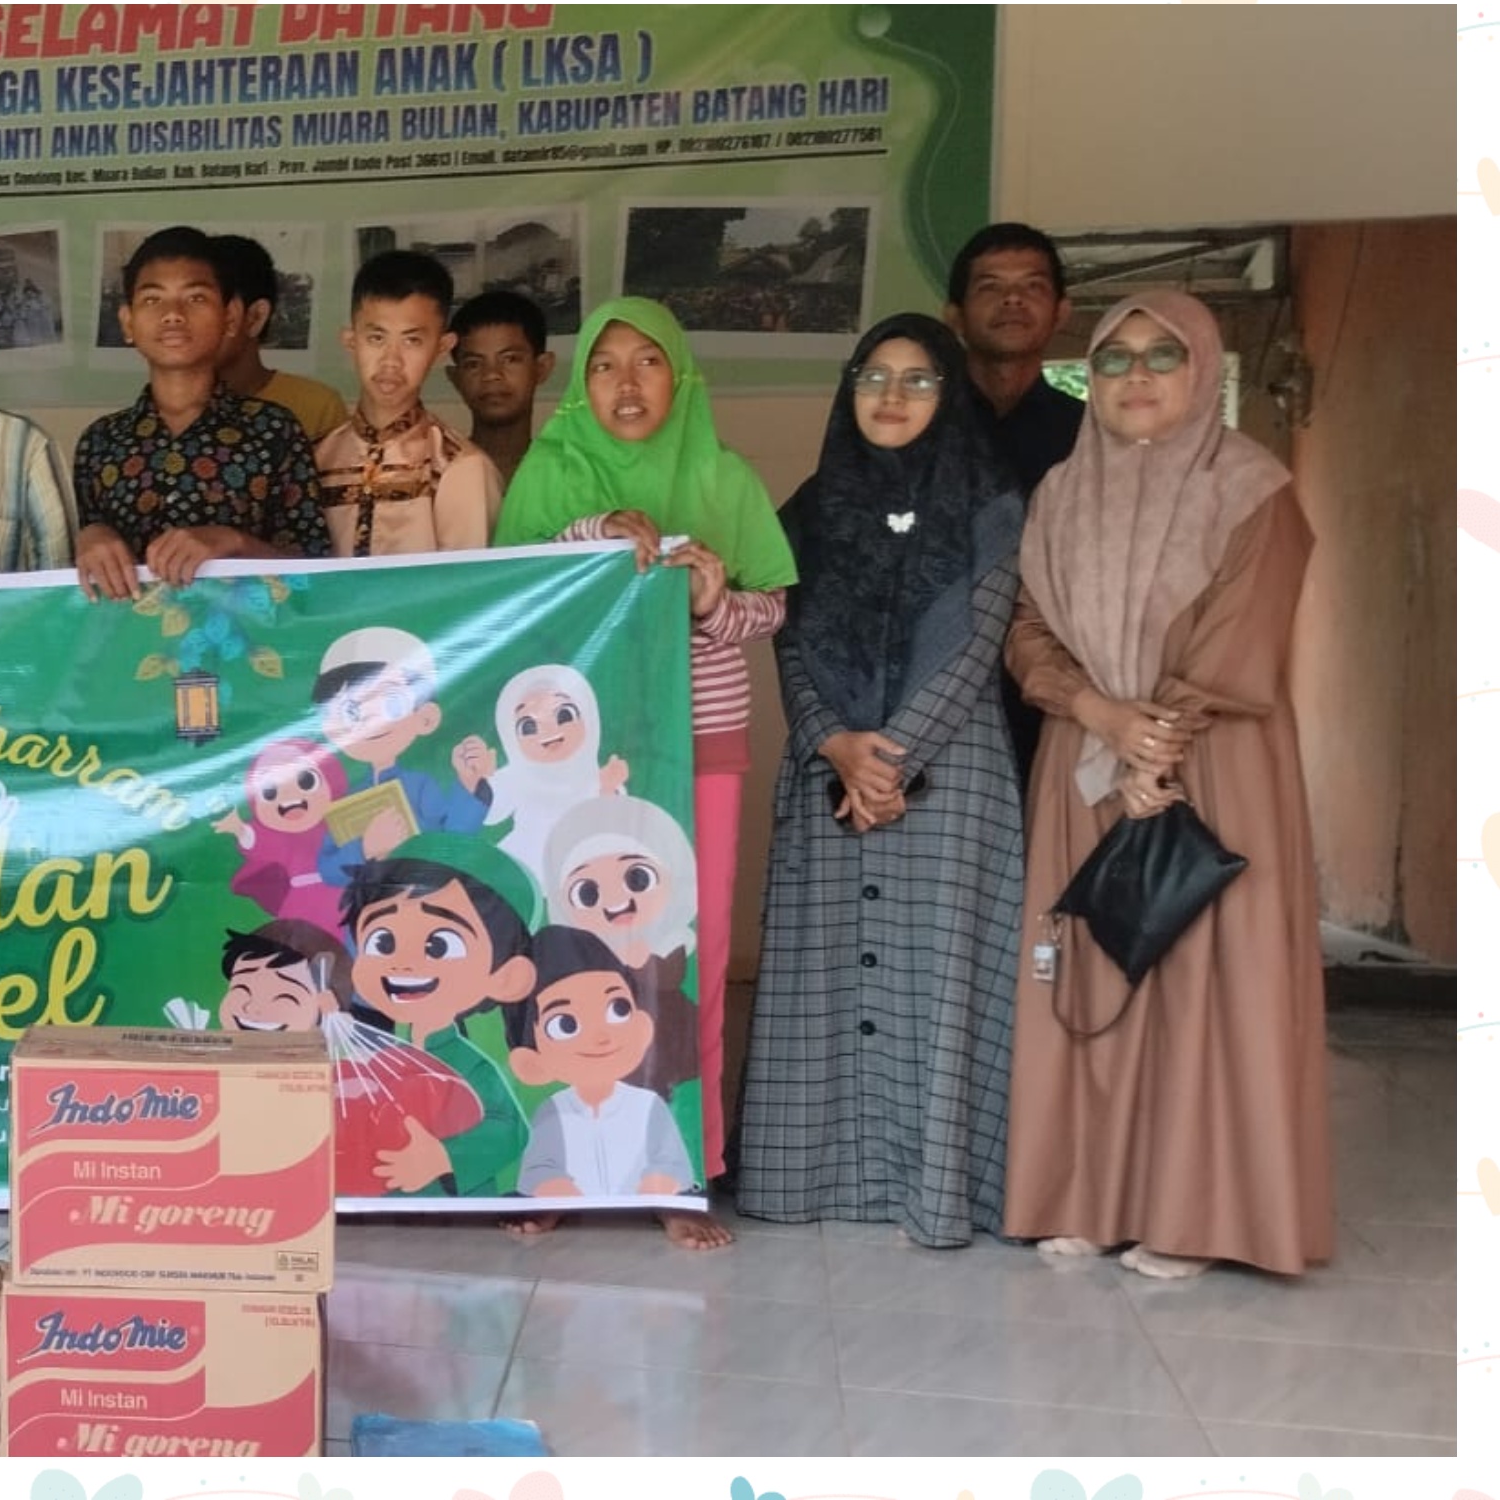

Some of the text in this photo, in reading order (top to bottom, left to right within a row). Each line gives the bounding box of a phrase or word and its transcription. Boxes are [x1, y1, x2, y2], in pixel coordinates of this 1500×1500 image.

[55, 51, 359, 115] KESEJAHTERAAN
[375, 42, 476, 97] ANAK
[521, 35, 623, 88] LKSA
[50, 123, 119, 158] ANAK
[127, 115, 282, 154] DISABILITAS
[293, 112, 389, 148] MUARA
[402, 103, 505, 142] BULIAN,
[517, 90, 681, 134] KABUPATEN
[692, 83, 807, 125] BATANG
[818, 77, 889, 116] HARI
[72, 1160, 162, 1180] Mi Instan
[134, 1206, 276, 1236] goreng
[60, 1388, 148, 1410] Mi Instan
[125, 1434, 261, 1457] goreng
